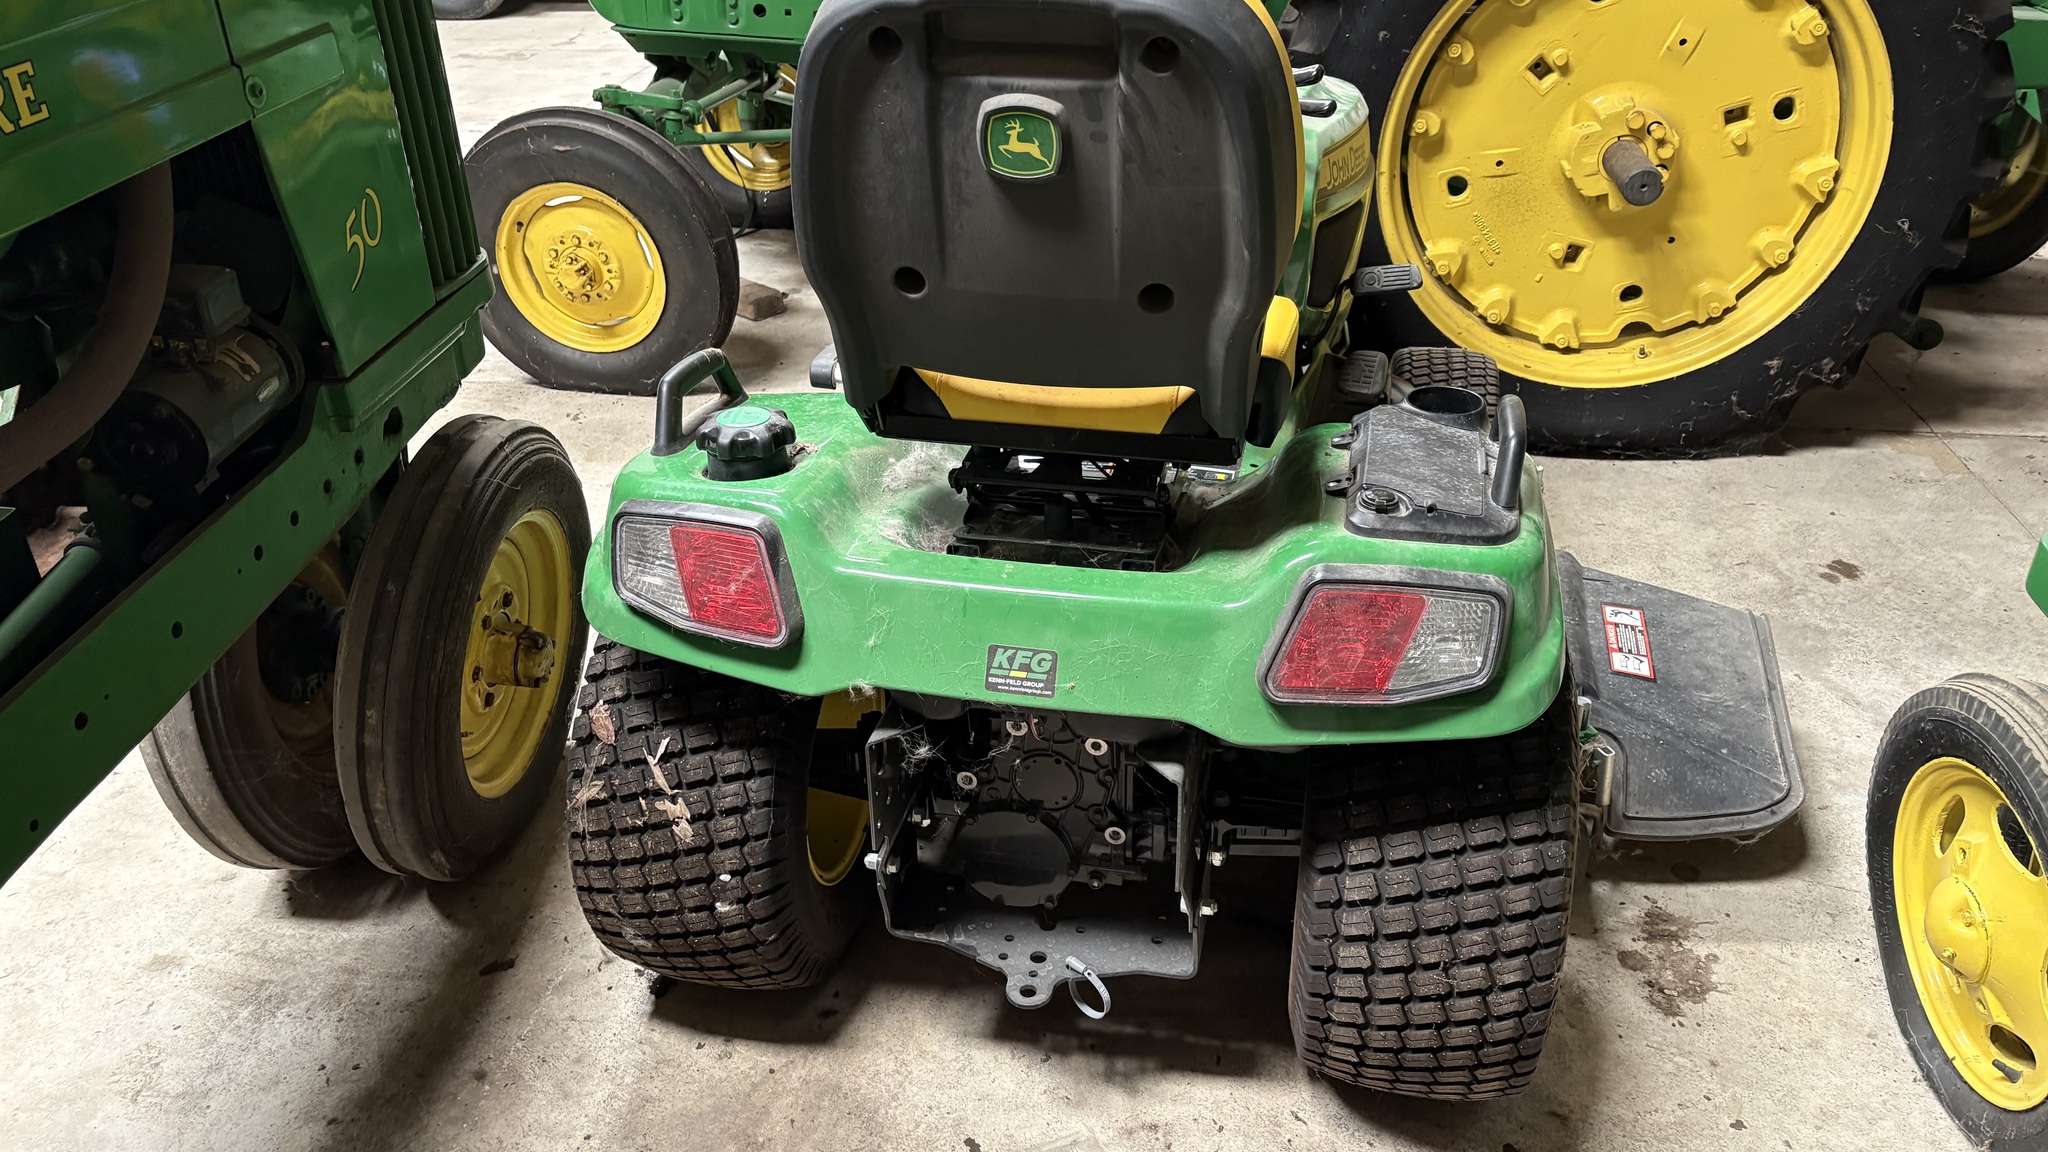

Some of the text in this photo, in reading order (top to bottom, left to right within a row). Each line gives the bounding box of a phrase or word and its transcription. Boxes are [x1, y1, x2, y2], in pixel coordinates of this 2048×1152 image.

[1326, 155, 1350, 189] JOHN
[346, 187, 382, 292] 50
[991, 648, 1053, 673] KFG
[988, 677, 1022, 686] KENN-FELD
[997, 685, 1052, 695] www.kennfeldgroup.com
